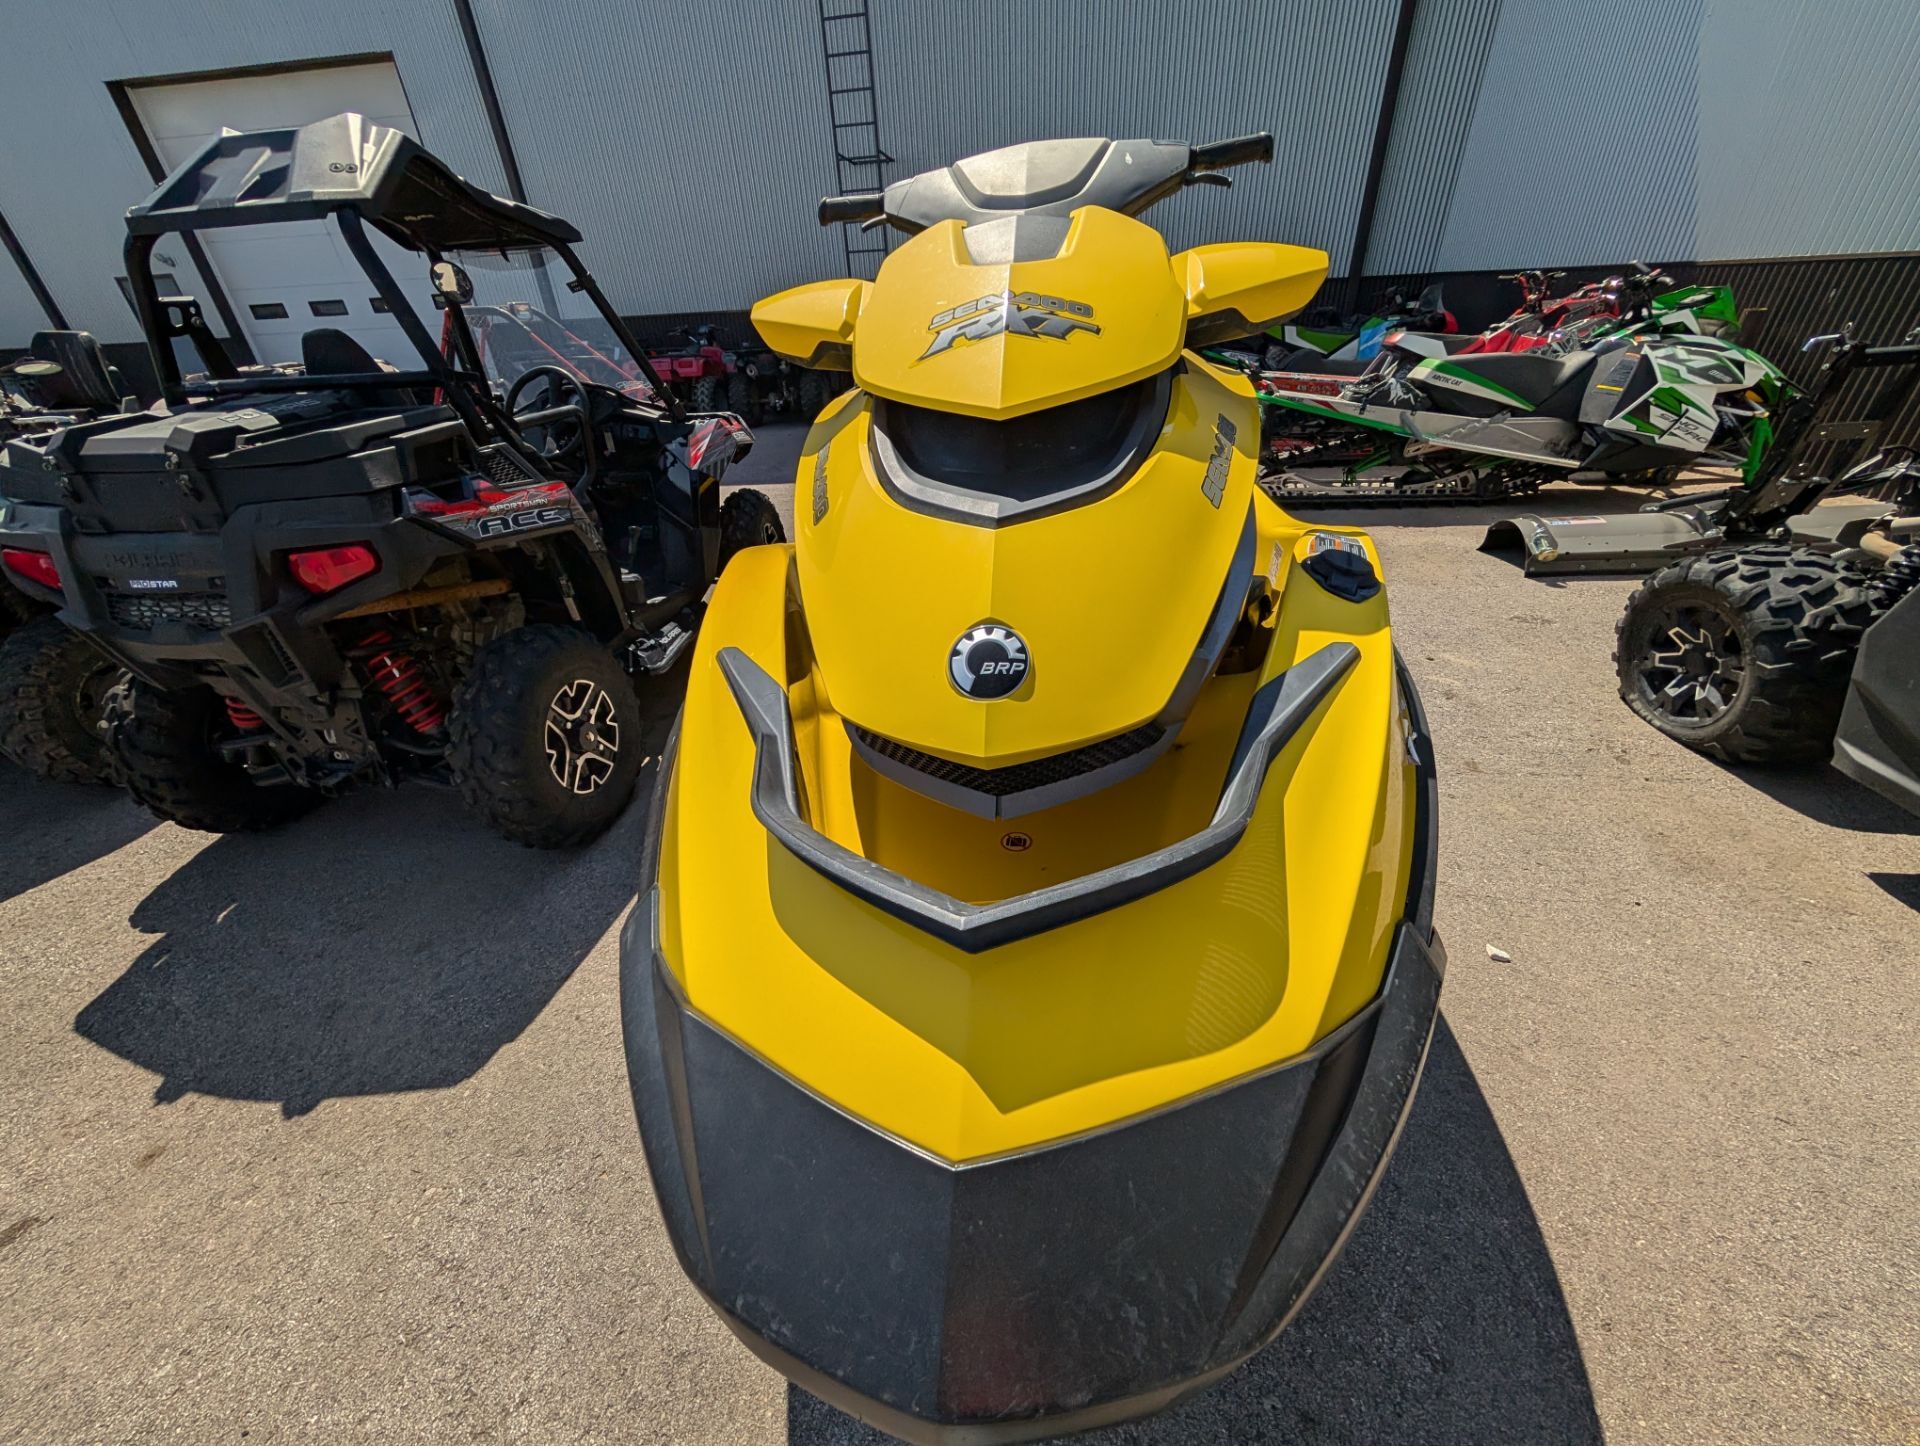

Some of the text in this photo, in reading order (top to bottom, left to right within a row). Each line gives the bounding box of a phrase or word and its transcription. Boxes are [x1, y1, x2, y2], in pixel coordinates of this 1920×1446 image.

[914, 301, 1101, 361] RXT
[1657, 413, 1699, 431] SNO
[1673, 425, 1708, 444] PRO
[489, 498, 548, 512] SPORTSMAN
[478, 506, 567, 537] ACE
[979, 661, 1025, 675] BRP
